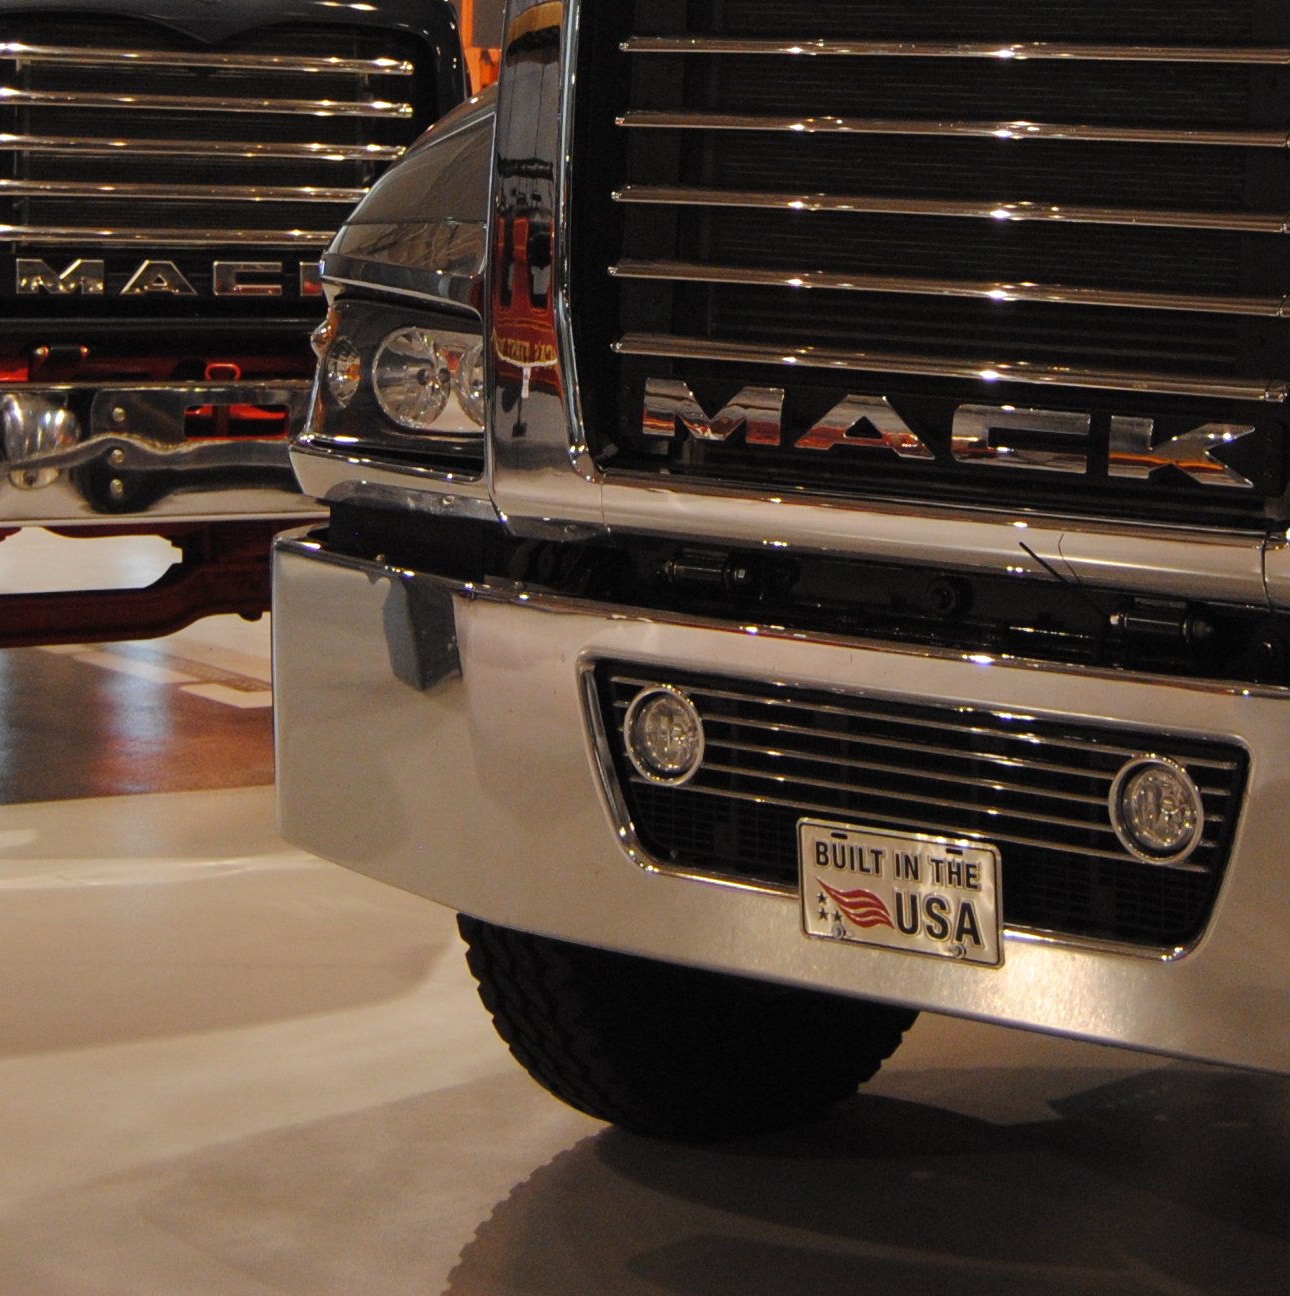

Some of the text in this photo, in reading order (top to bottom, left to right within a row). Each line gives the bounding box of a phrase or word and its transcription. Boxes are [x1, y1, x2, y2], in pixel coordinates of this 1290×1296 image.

[642, 377, 1255, 488] MACK
[815, 841, 979, 890] BUILT IN THE
[895, 891, 981, 946] USA
